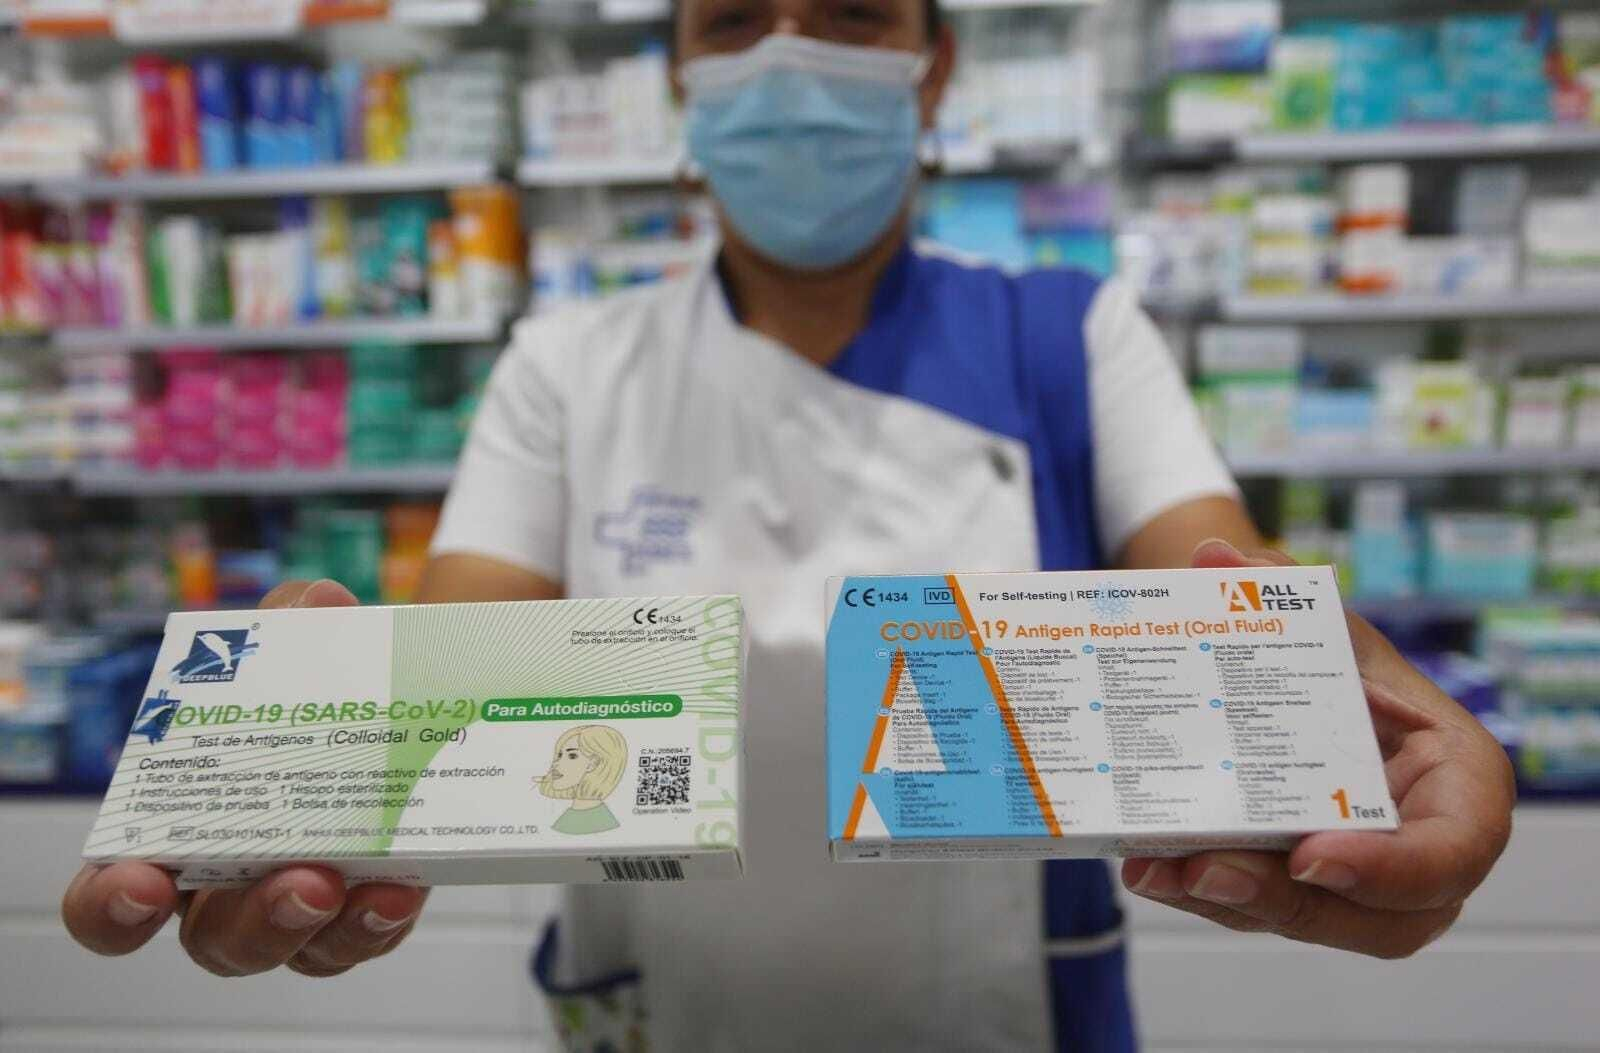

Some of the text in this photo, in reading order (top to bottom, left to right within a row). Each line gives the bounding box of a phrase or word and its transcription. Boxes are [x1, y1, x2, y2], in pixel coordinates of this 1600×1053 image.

[878, 592, 908, 602] 1434
[928, 591, 951, 601] IVD
[979, 592, 999, 602] For
[1001, 590, 1068, 604] Self-testing
[1077, 589, 1104, 599] REF:
[1107, 588, 1170, 599] ICOV-802H
[1262, 584, 1297, 596] ALL
[1263, 598, 1316, 611] TEST
[880, 617, 1285, 642] COVID-19 Antigen Rapid Test (Oral Fluid)
[175, 702, 284, 728] OVID-19
[290, 698, 477, 728] (SARS-CoV-2)
[487, 700, 674, 719] Para Autodiagnóstico
[192, 727, 467, 749] Test de Antígenos (Colloidal Gold)
[138, 755, 222, 770] Contenido:
[177, 771, 194, 783] de
[263, 768, 281, 781] de
[340, 769, 365, 781] con
[366, 767, 418, 780] reactivo
[419, 767, 437, 779] de
[438, 765, 506, 778] extracción
[224, 784, 242, 796] de
[243, 785, 269, 797] uso
[288, 783, 336, 797] Hisopo
[205, 799, 222, 811] de
[224, 798, 272, 813] prueba
[331, 797, 349, 809] de
[1331, 788, 1350, 819] 1
[1351, 805, 1386, 820] Test
[387, 826, 429, 837] MEDICAL
[431, 825, 498, 836] TECHNOLOGY
